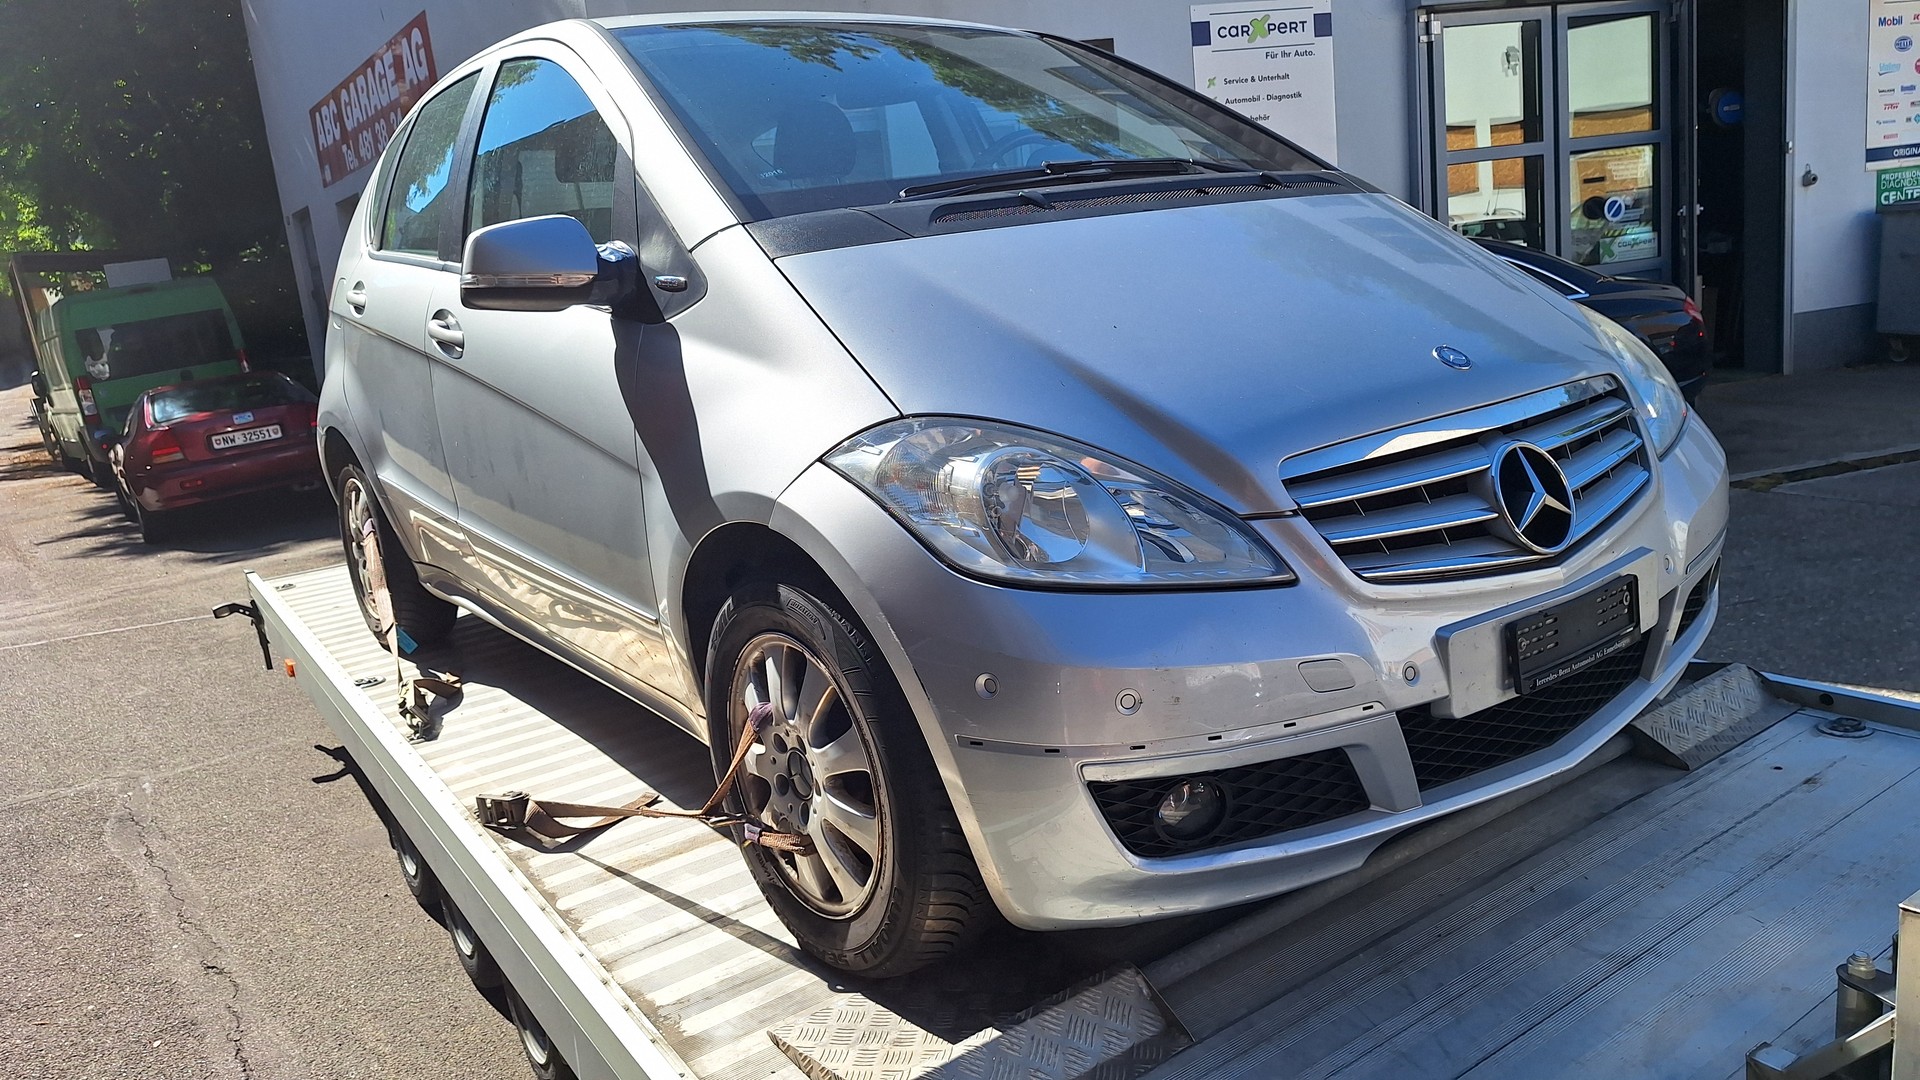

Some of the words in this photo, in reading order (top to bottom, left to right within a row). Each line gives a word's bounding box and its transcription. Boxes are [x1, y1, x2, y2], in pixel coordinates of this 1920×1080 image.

[1878, 15, 1903, 27] Mobil
[1265, 51, 1278, 60] Für
[1281, 50, 1292, 59] Ihr
[1294, 50, 1316, 58] Auto.
[1223, 77, 1249, 85] Service
[1250, 75, 1256, 83] &
[1258, 73, 1290, 82] Unterhalt
[315, 99, 341, 151] ABC
[340, 50, 400, 131] GARAGE
[401, 27, 430, 89] AG
[1225, 94, 1261, 105] Automobil
[1266, 91, 1302, 102] Diagnostik
[358, 127, 376, 162] 481
[221, 434, 236, 446] NW
[241, 429, 272, 443] 32551
